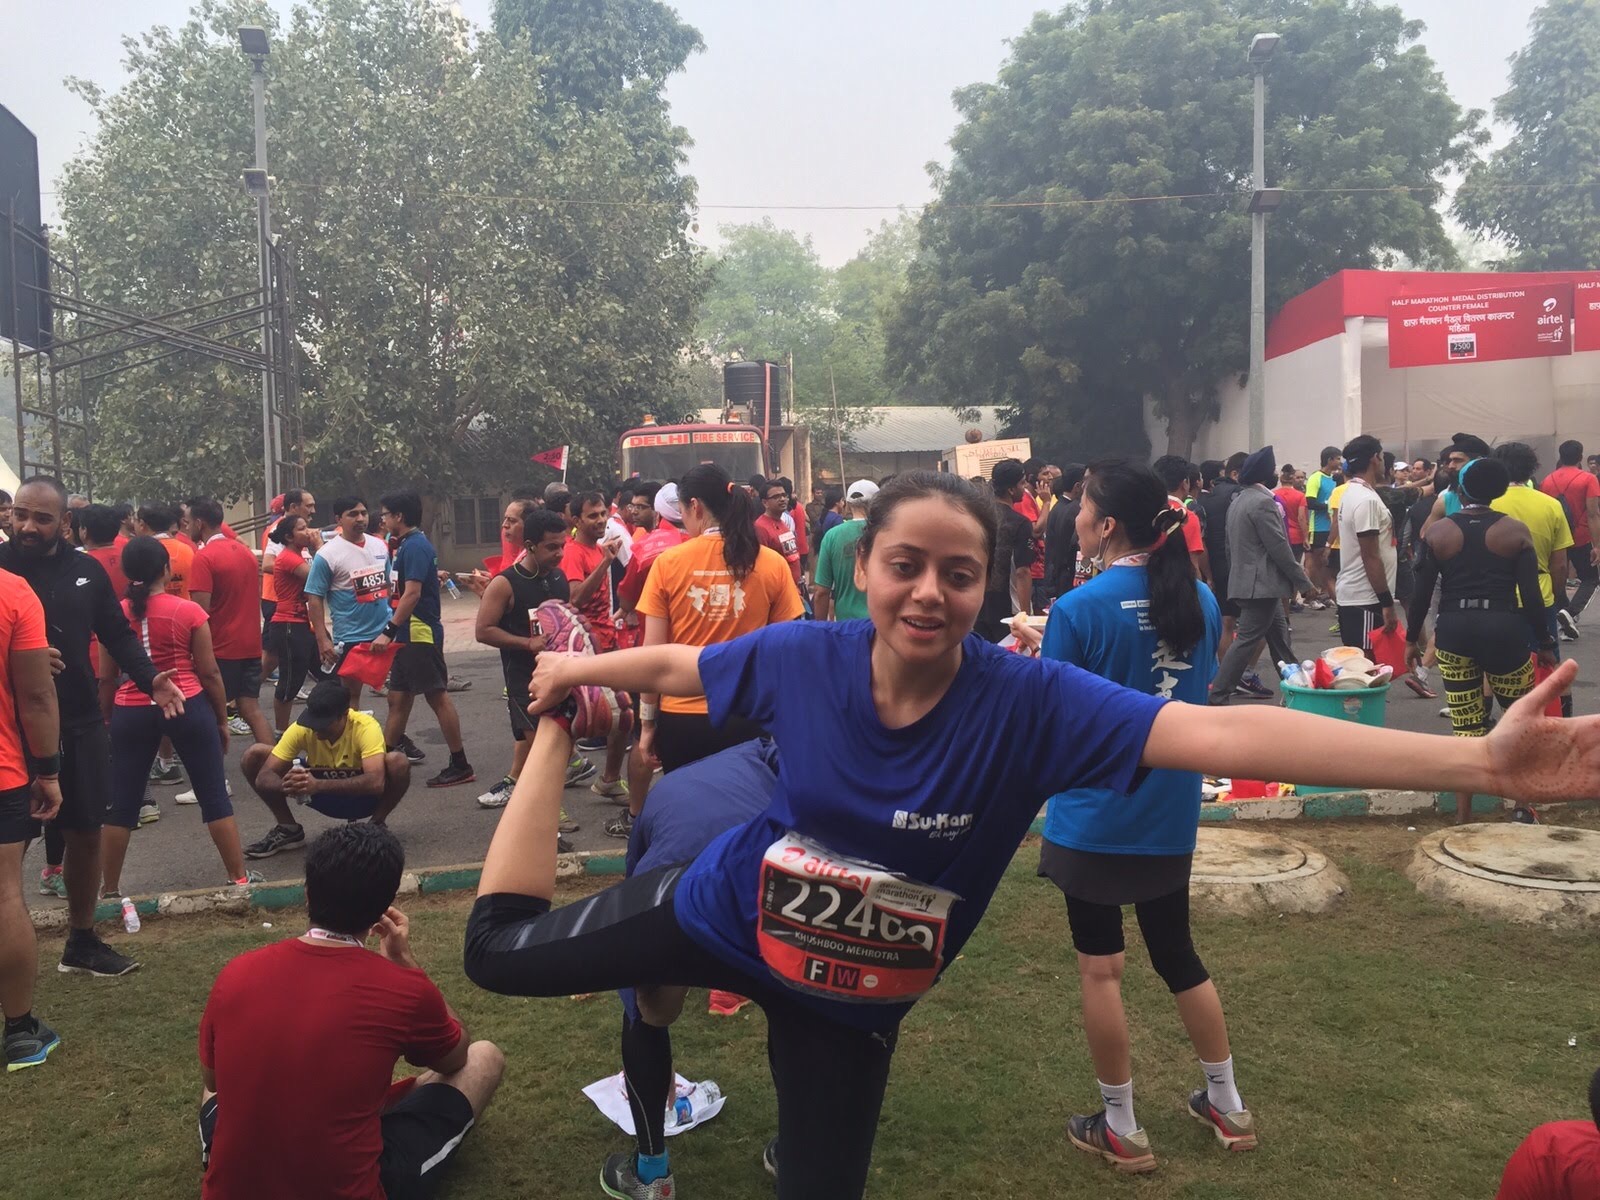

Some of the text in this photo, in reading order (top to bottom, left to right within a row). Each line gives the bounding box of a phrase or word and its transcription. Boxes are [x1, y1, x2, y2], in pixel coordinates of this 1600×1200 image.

[1577, 281, 1596, 289] HALF
[1411, 296, 1449, 305] MARATHON
[1452, 294, 1476, 302] MEDAL
[1477, 291, 1525, 300] DISTRIBUTION
[1428, 302, 1489, 312] COUNTER FEMALE
[1537, 314, 1563, 325] airtel
[629, 432, 755, 447] DELHI FIRE SERVICE
[362, 572, 386, 588] 4852
[1450, 693, 1469, 703] LINE
[803, 855, 873, 894] airtel
[876, 888, 920, 901] marathon
[795, 931, 900, 961] KHUSHBOO MEHROTRA
[809, 959, 858, 987] F W
